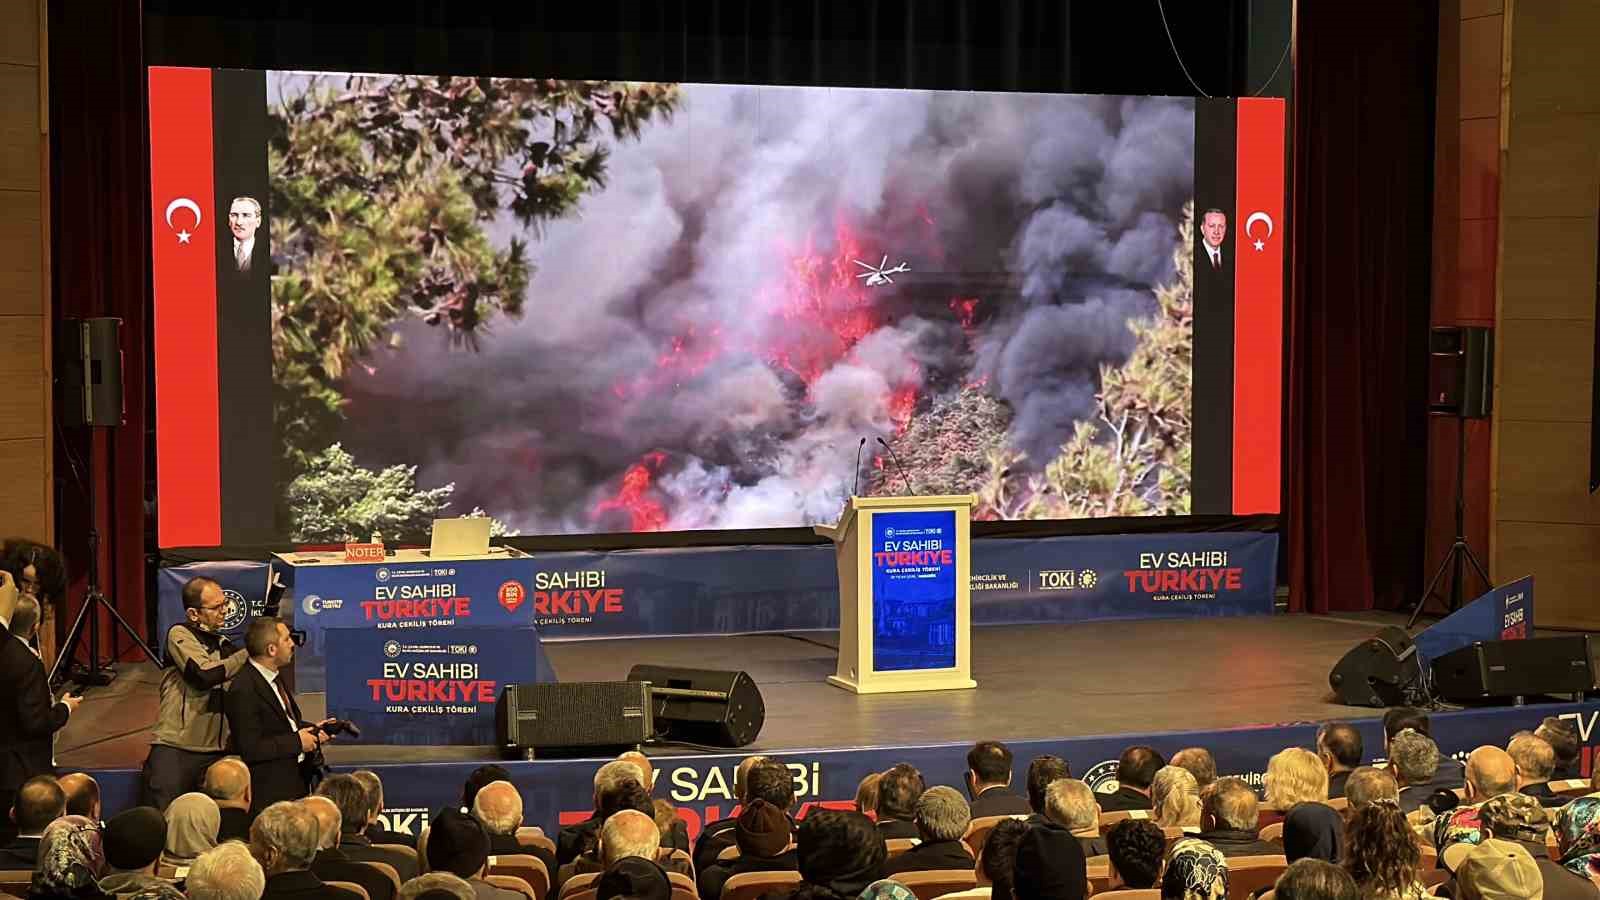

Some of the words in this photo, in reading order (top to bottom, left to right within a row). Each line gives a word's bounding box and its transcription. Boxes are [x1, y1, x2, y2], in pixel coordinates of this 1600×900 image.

[346, 547, 384, 558] NOTER
[885, 541, 900, 552] EV
[1140, 552, 1164, 569] EV
[376, 586, 398, 600] EV
[534, 589, 624, 615] RKİYE
[384, 663, 409, 679] EV
[386, 705, 410, 713] KURA
